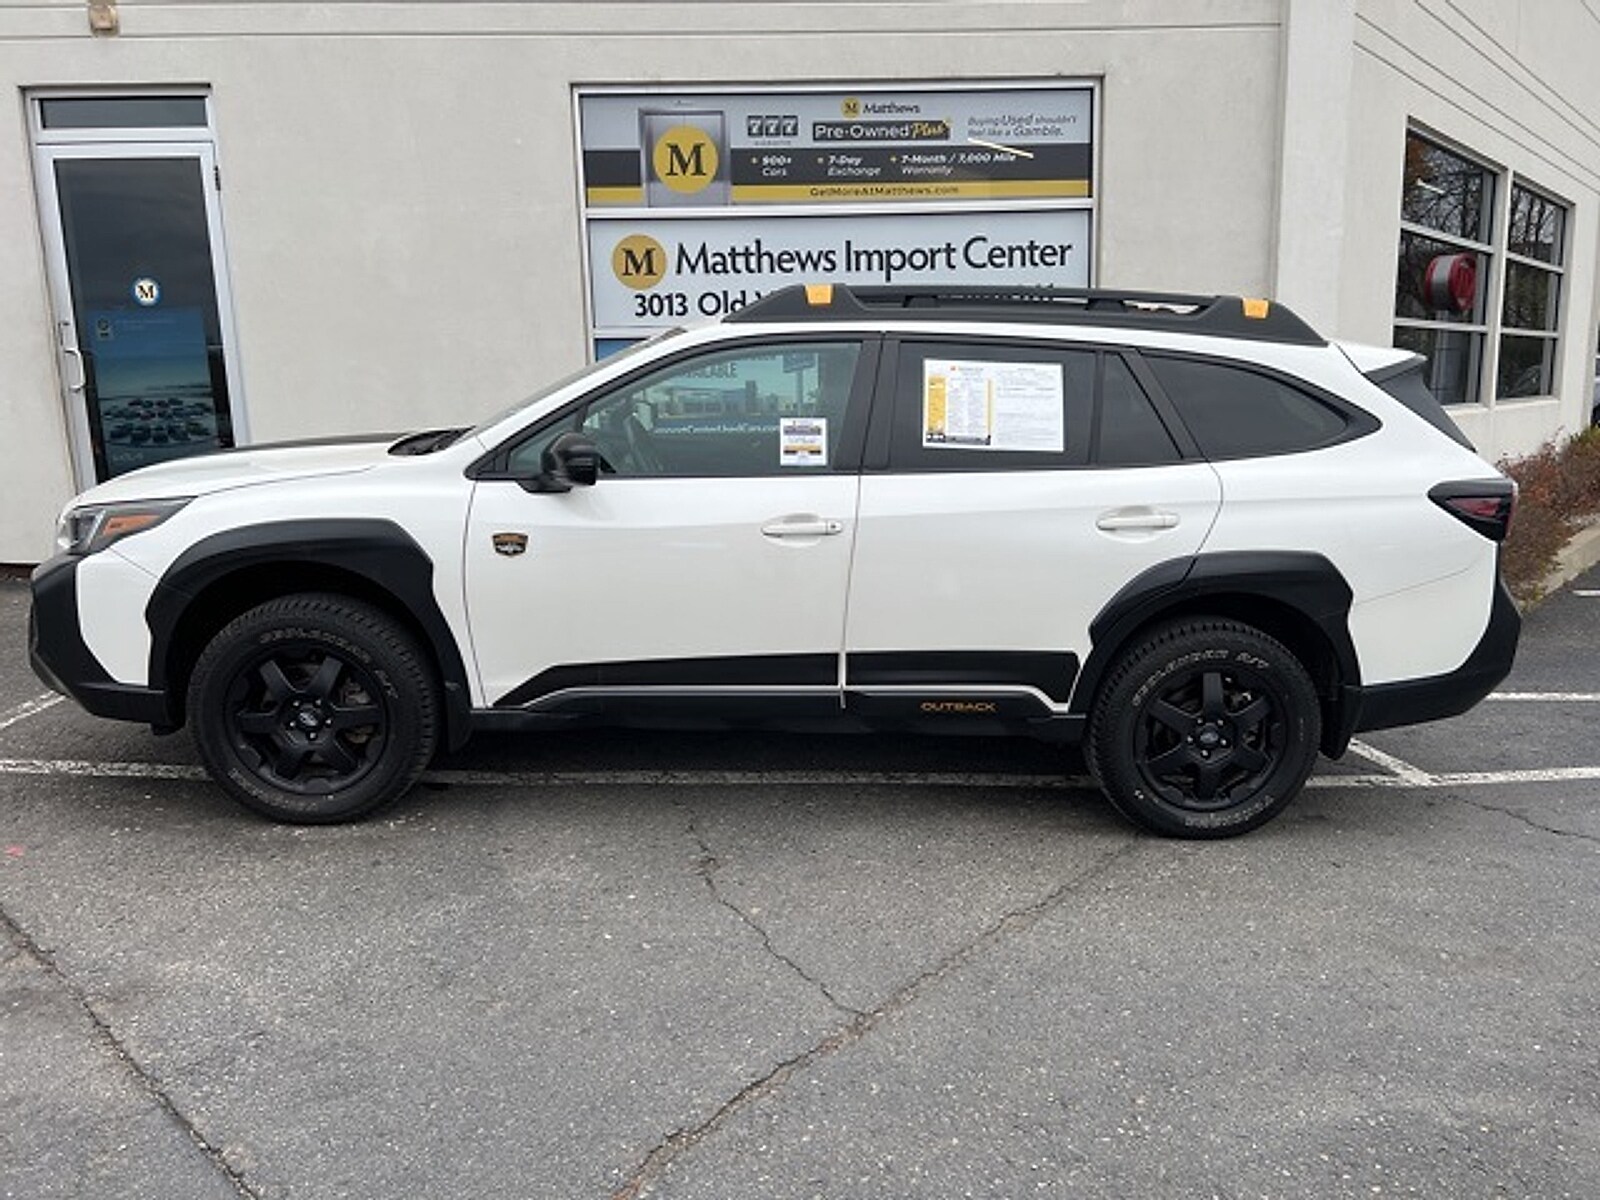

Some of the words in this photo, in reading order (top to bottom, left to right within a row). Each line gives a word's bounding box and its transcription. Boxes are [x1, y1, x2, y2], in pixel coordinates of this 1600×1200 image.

[862, 101, 921, 113] Matthews
[748, 116, 798, 135] 777
[968, 117, 997, 126] Buying
[1002, 113, 1034, 126] Used
[1035, 115, 1077, 125] shouldn't
[814, 124, 909, 139] Pre-Owned
[1013, 126, 1064, 137] Gamble.
[664, 142, 707, 176] M
[827, 155, 862, 166] 7-Day
[901, 154, 947, 165] 7-Month
[993, 151, 1017, 163] Mile
[762, 167, 787, 176] Cars
[827, 167, 881, 177] Exchange
[902, 165, 954, 176] Warranty
[621, 247, 658, 277] M
[675, 238, 836, 275] Matthews
[845, 239, 957, 283] Import
[963, 236, 1073, 269] Center
[634, 292, 689, 317] 3013
[698, 290, 747, 316] Old
[920, 701, 997, 712] OUTBACK
